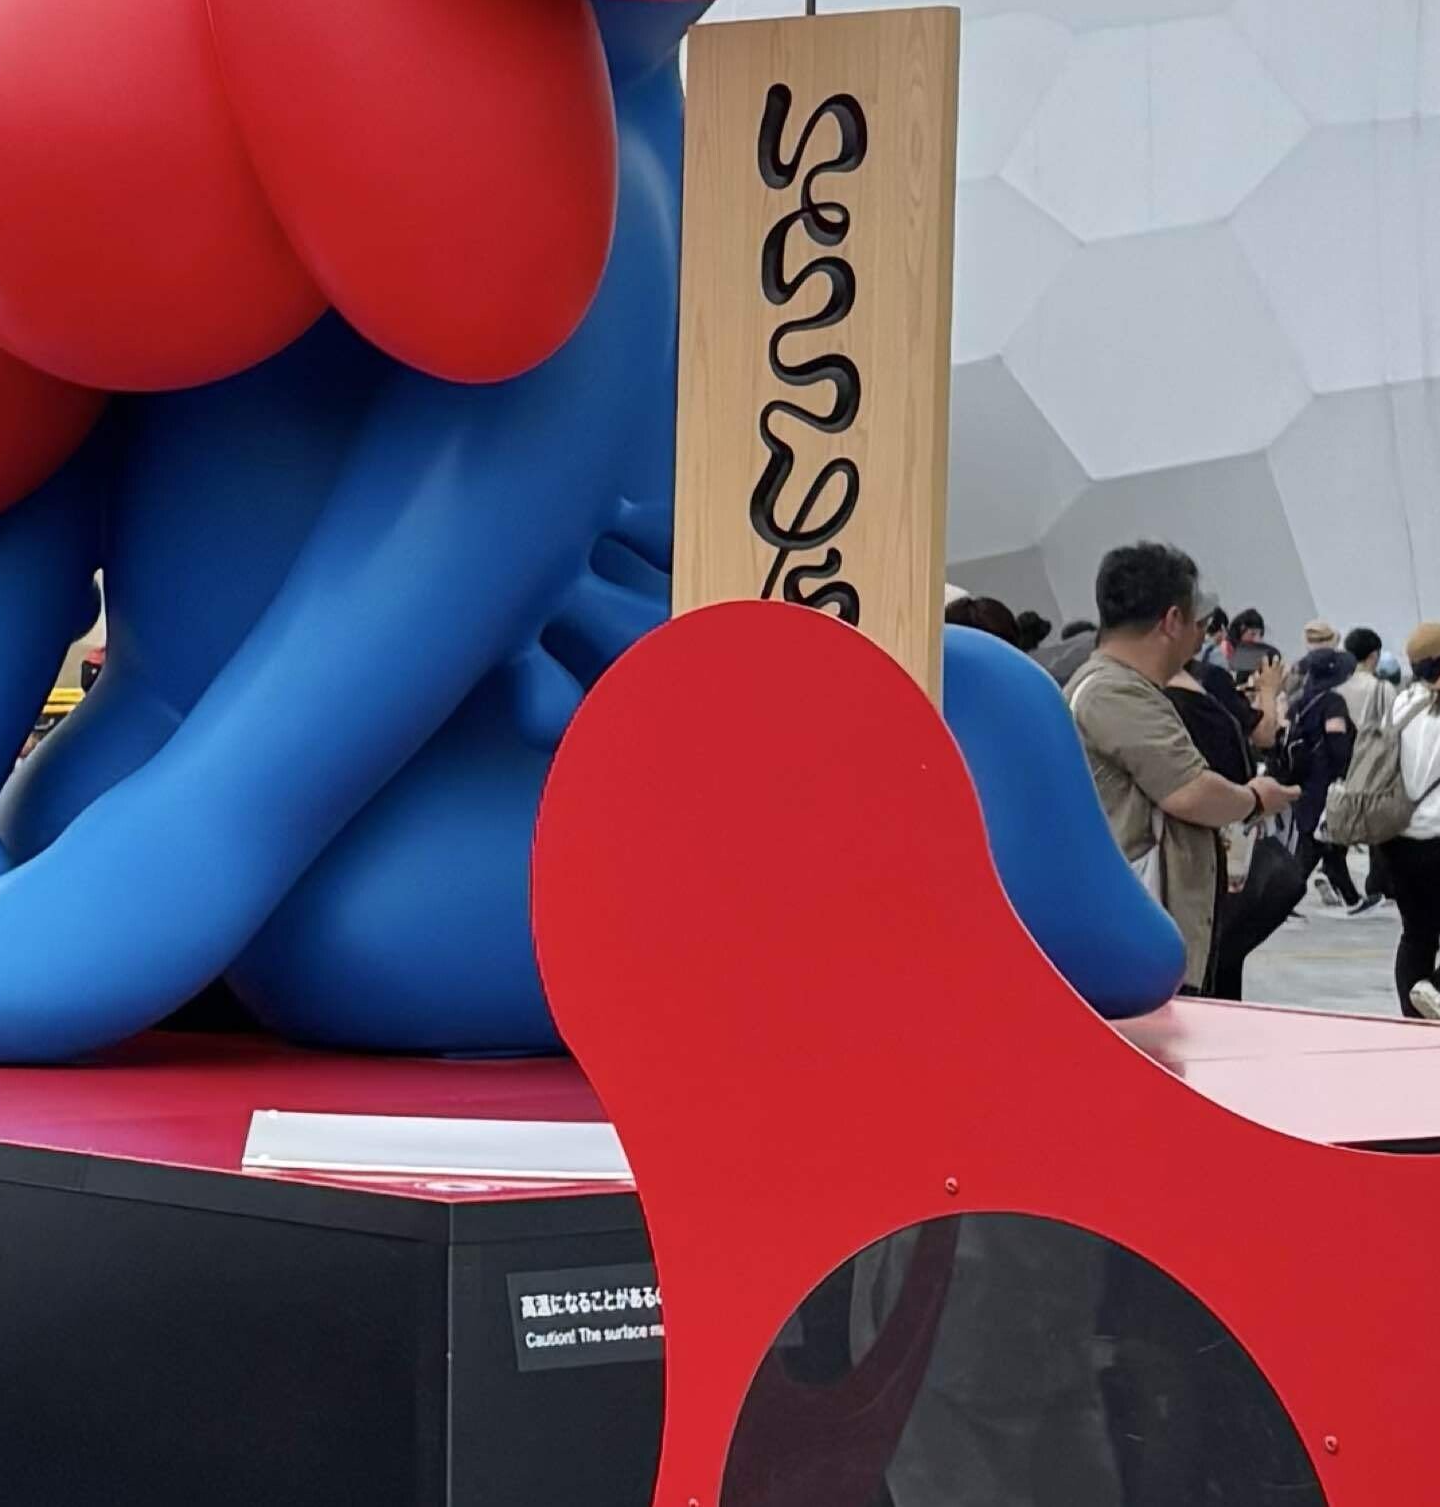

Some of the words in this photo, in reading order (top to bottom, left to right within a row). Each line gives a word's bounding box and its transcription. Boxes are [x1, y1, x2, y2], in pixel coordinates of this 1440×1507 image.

[526, 1329, 576, 1348] Caution!
[578, 1327, 601, 1343] The
[604, 1324, 648, 1341] surface
